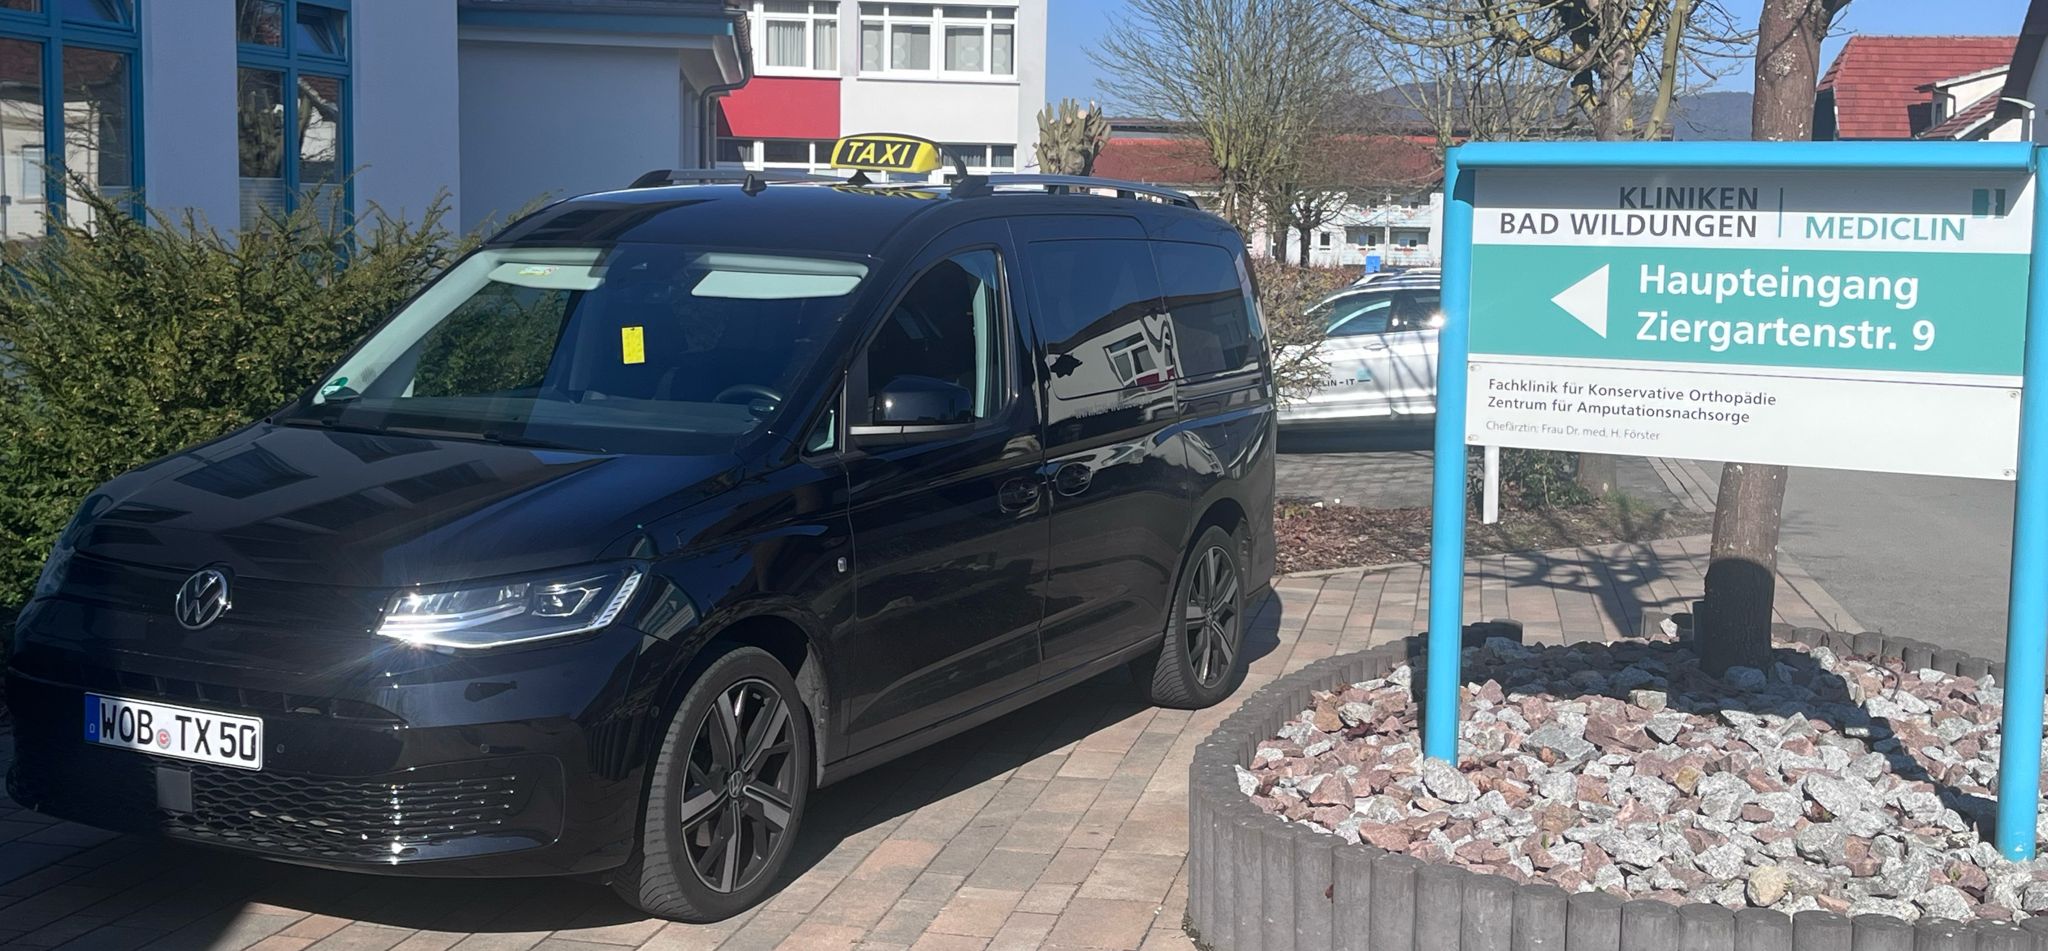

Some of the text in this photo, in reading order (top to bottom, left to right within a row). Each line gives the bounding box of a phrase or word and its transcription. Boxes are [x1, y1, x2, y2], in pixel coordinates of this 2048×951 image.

[847, 141, 912, 166] TAXI
[1619, 186, 1759, 210] KLINIKEN
[1500, 212, 1757, 238] BAD WILDUNGEN
[1805, 215, 1966, 241] MEDICLIN
[1639, 264, 1919, 310] Haupteingang
[1636, 310, 1936, 352] Ziergartenstr. 9
[1489, 378, 1777, 407] Fachklinik für Konservative Orthopädie
[1488, 396, 1750, 426] Zentrum für Amputationsnachsorge
[1541, 423, 1564, 434] Frau
[1566, 425, 1580, 436] Dr.
[1582, 427, 1608, 438] med.
[1611, 429, 1621, 438] H.
[1624, 428, 1661, 441] Förster
[101, 703, 257, 762] WOB TX 50
